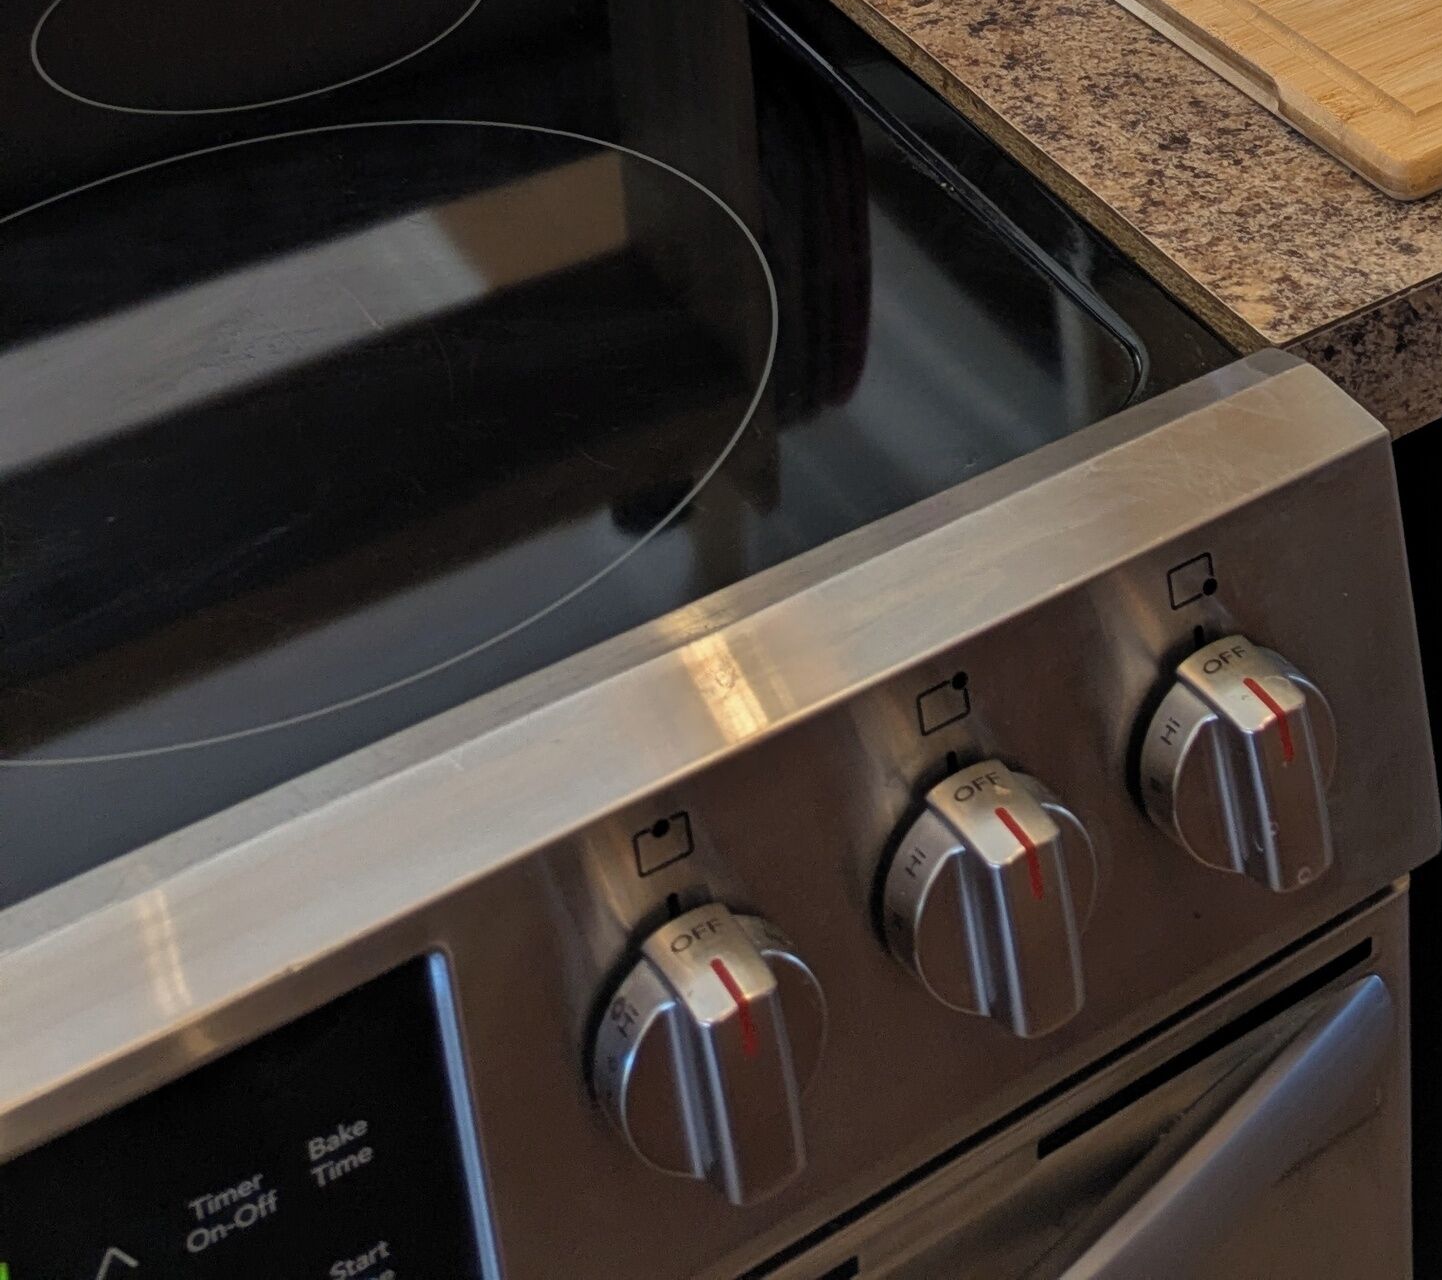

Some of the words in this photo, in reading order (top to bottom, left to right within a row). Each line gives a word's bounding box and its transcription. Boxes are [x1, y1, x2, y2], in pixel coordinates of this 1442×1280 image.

[1203, 645, 1247, 675] OFF
[953, 771, 1001, 802] OFF
[670, 917, 725, 953] OFF
[307, 1119, 369, 1162] Bake
[310, 1146, 374, 1188] Time
[188, 1173, 264, 1222] Timer
[186, 1189, 279, 1254] On-Off
[329, 1240, 391, 1280] Start
